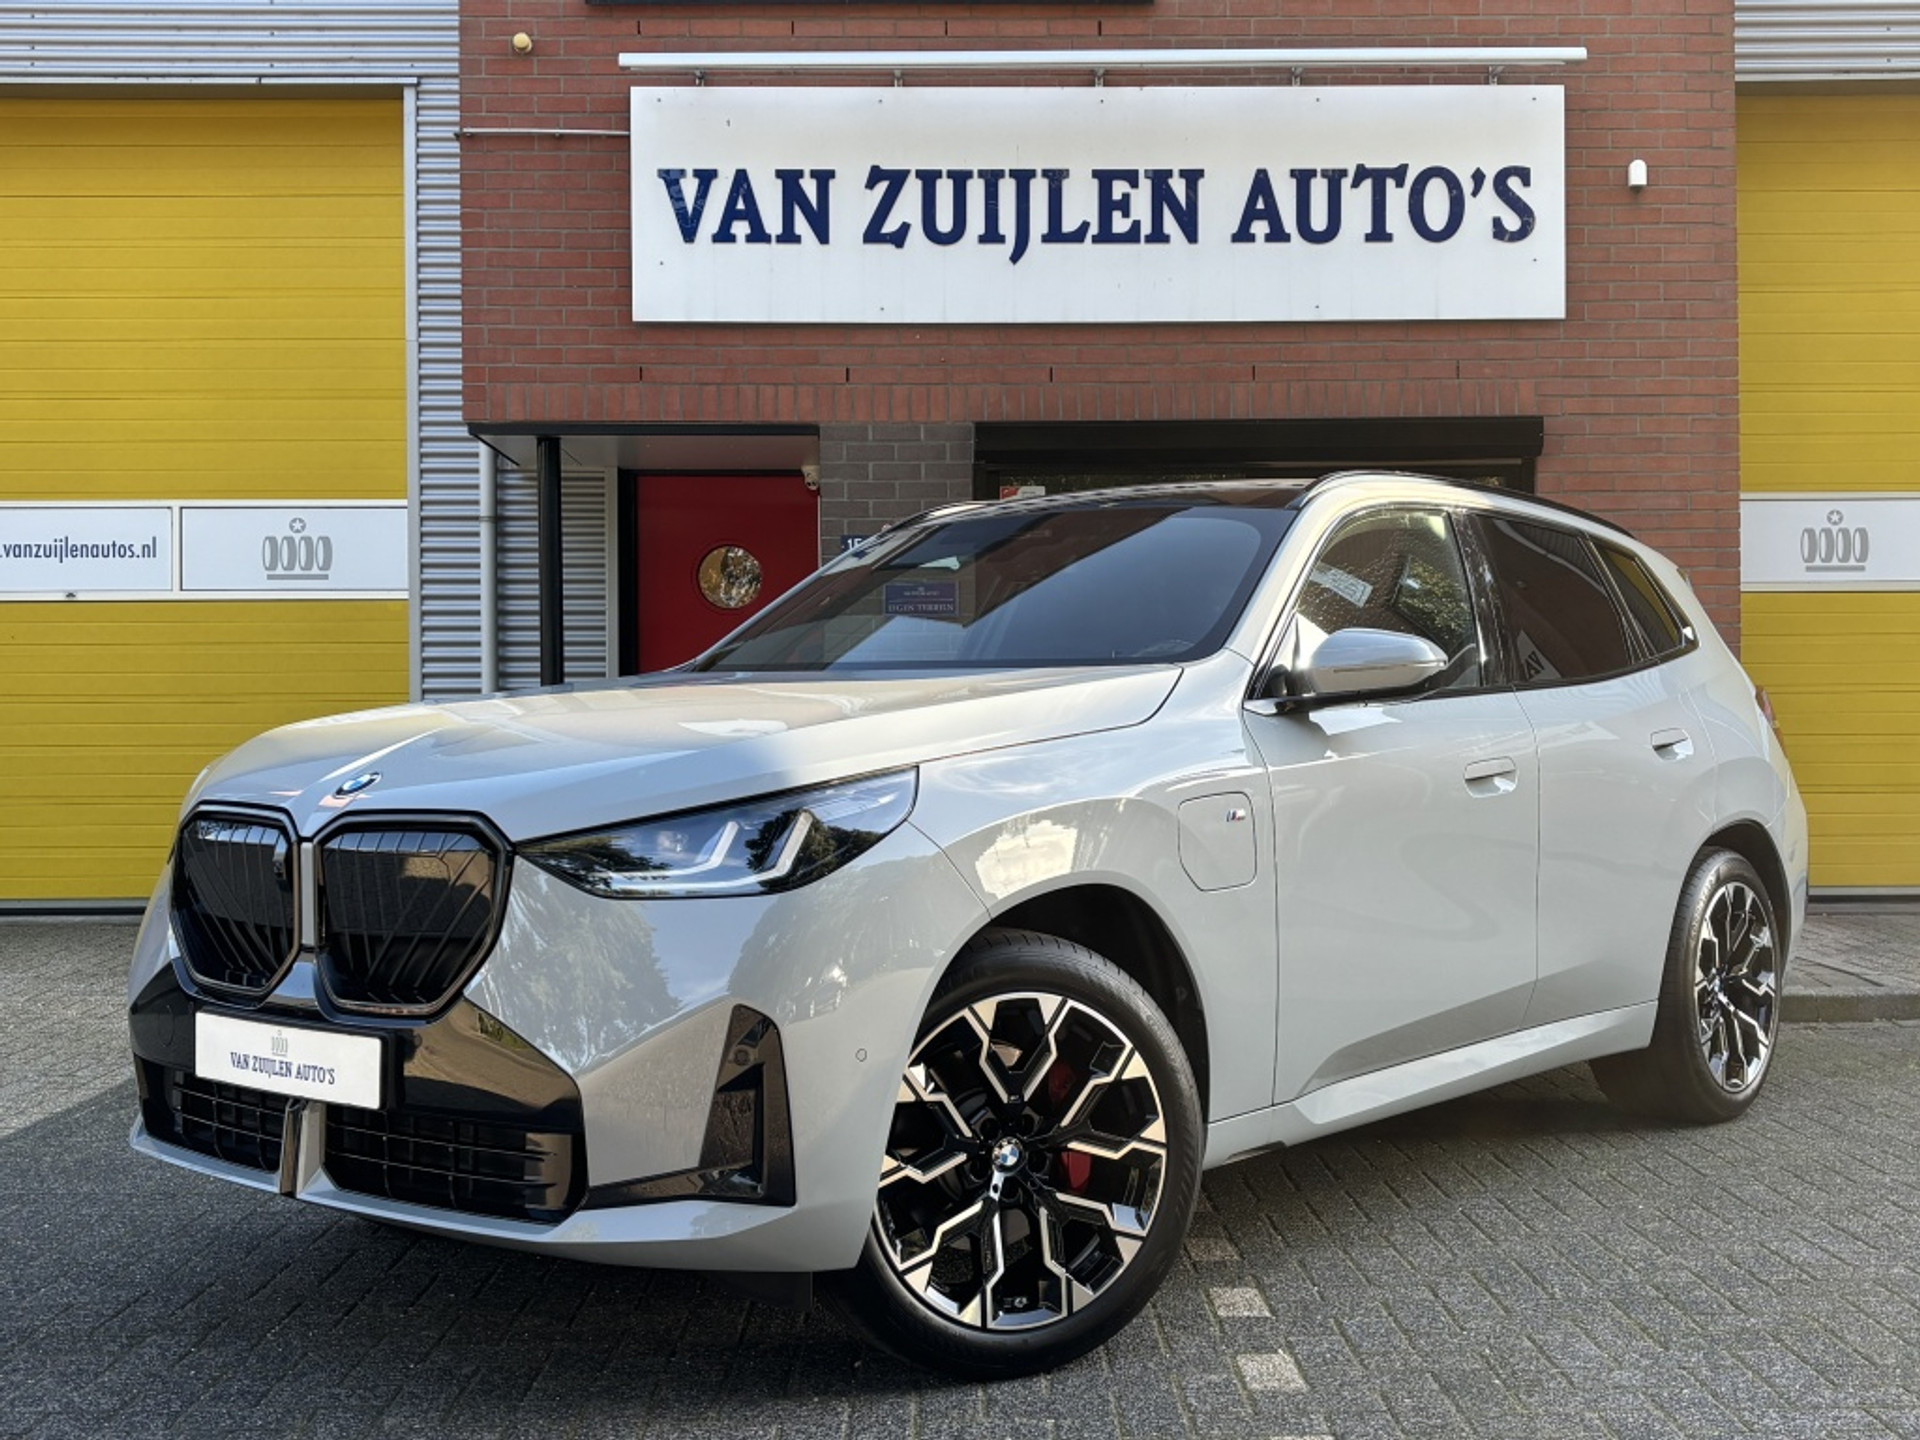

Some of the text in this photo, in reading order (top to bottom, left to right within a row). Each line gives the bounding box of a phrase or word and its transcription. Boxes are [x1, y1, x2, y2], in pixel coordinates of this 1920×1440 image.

[657, 163, 1536, 266] VAN ZUIJLEN AUTO'S
[230, 1051, 336, 1085] VAN ZUIJLEN AUTO'S
